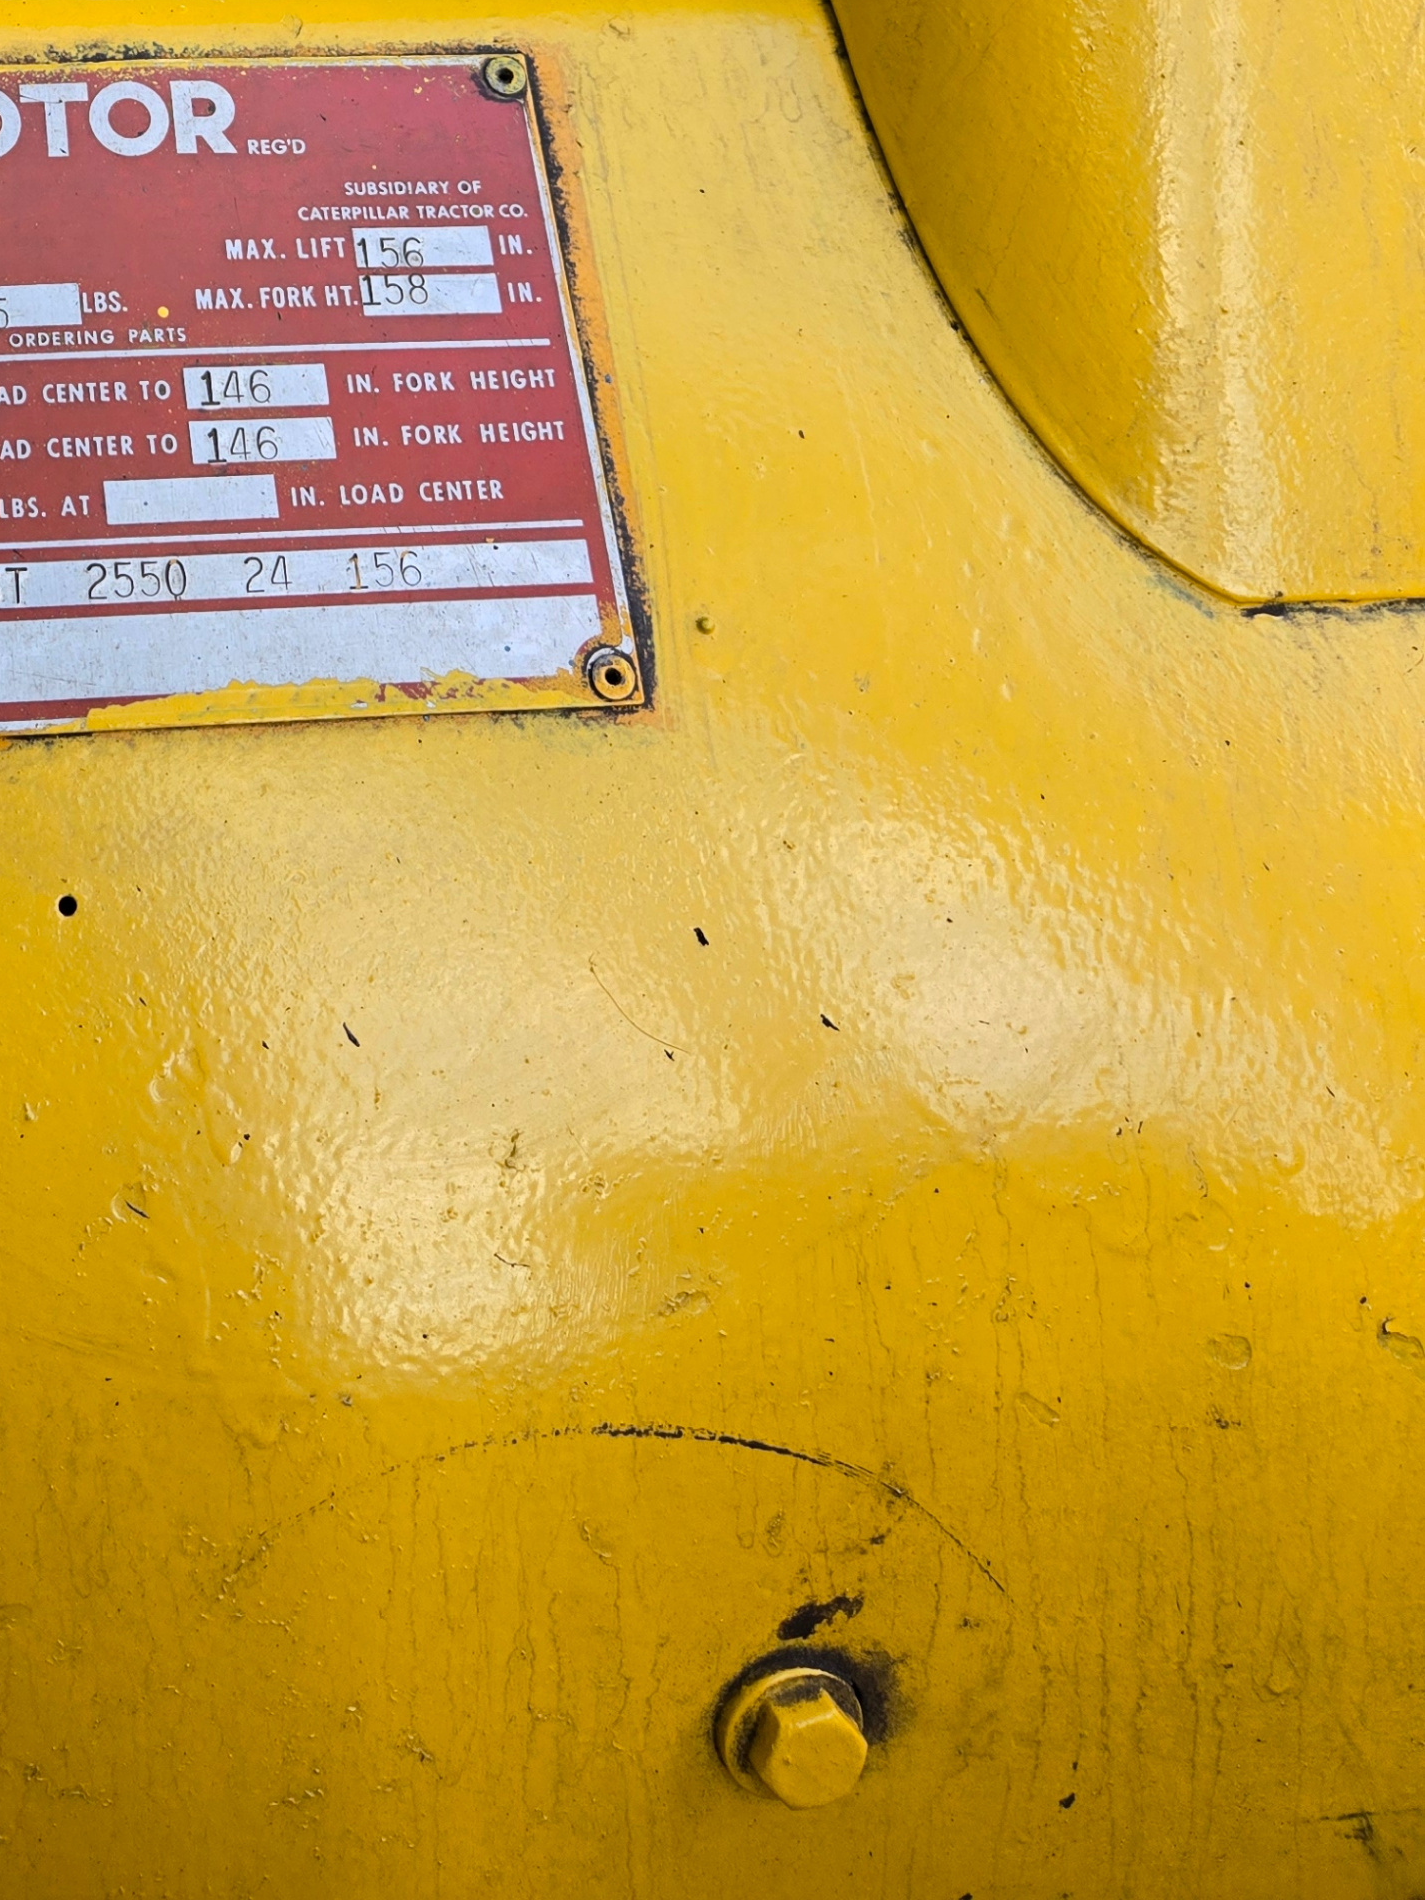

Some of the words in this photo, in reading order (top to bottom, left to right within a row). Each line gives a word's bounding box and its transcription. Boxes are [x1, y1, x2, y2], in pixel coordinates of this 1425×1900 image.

[248, 139, 305, 154] REG'D
[345, 181, 448, 195] SUBSIDIARY
[458, 181, 481, 194] OF
[298, 206, 409, 221] CATERPILLAR
[416, 205, 494, 218] TRACTOR
[499, 204, 527, 217] CO.
[225, 239, 285, 259] MAX.
[296, 238, 345, 258] LIFT
[357, 236, 425, 267] 156
[499, 235, 532, 254] IN.
[83, 291, 127, 313] LBS.
[196, 288, 252, 309] MAX.
[260, 286, 317, 308] FORK
[325, 286, 359, 306] HT.
[361, 273, 429, 306] 158
[508, 282, 541, 302] IN.
[9, 330, 114, 347] ORDERING
[129, 328, 186, 343] PARTS
[43, 382, 127, 403] CENTER
[139, 380, 170, 400] TO
[200, 369, 272, 408] 146
[347, 374, 379, 393] IN.
[393, 372, 454, 392] FORK
[470, 369, 554, 389] HEIGHT
[47, 436, 134, 459] CENTER
[146, 434, 177, 454] TO
[206, 425, 279, 464] 146
[354, 427, 388, 446] IN.
[401, 425, 462, 445] FORK
[480, 421, 563, 442] HEIGHT
[0, 497, 46, 518] LBS.
[62, 495, 89, 516] AT
[291, 487, 324, 506] IN.
[340, 483, 403, 505] LOAD
[420, 480, 503, 501] CENTER
[86, 559, 187, 601] 2550
[244, 556, 292, 593] 24
[348, 551, 423, 590] 156
